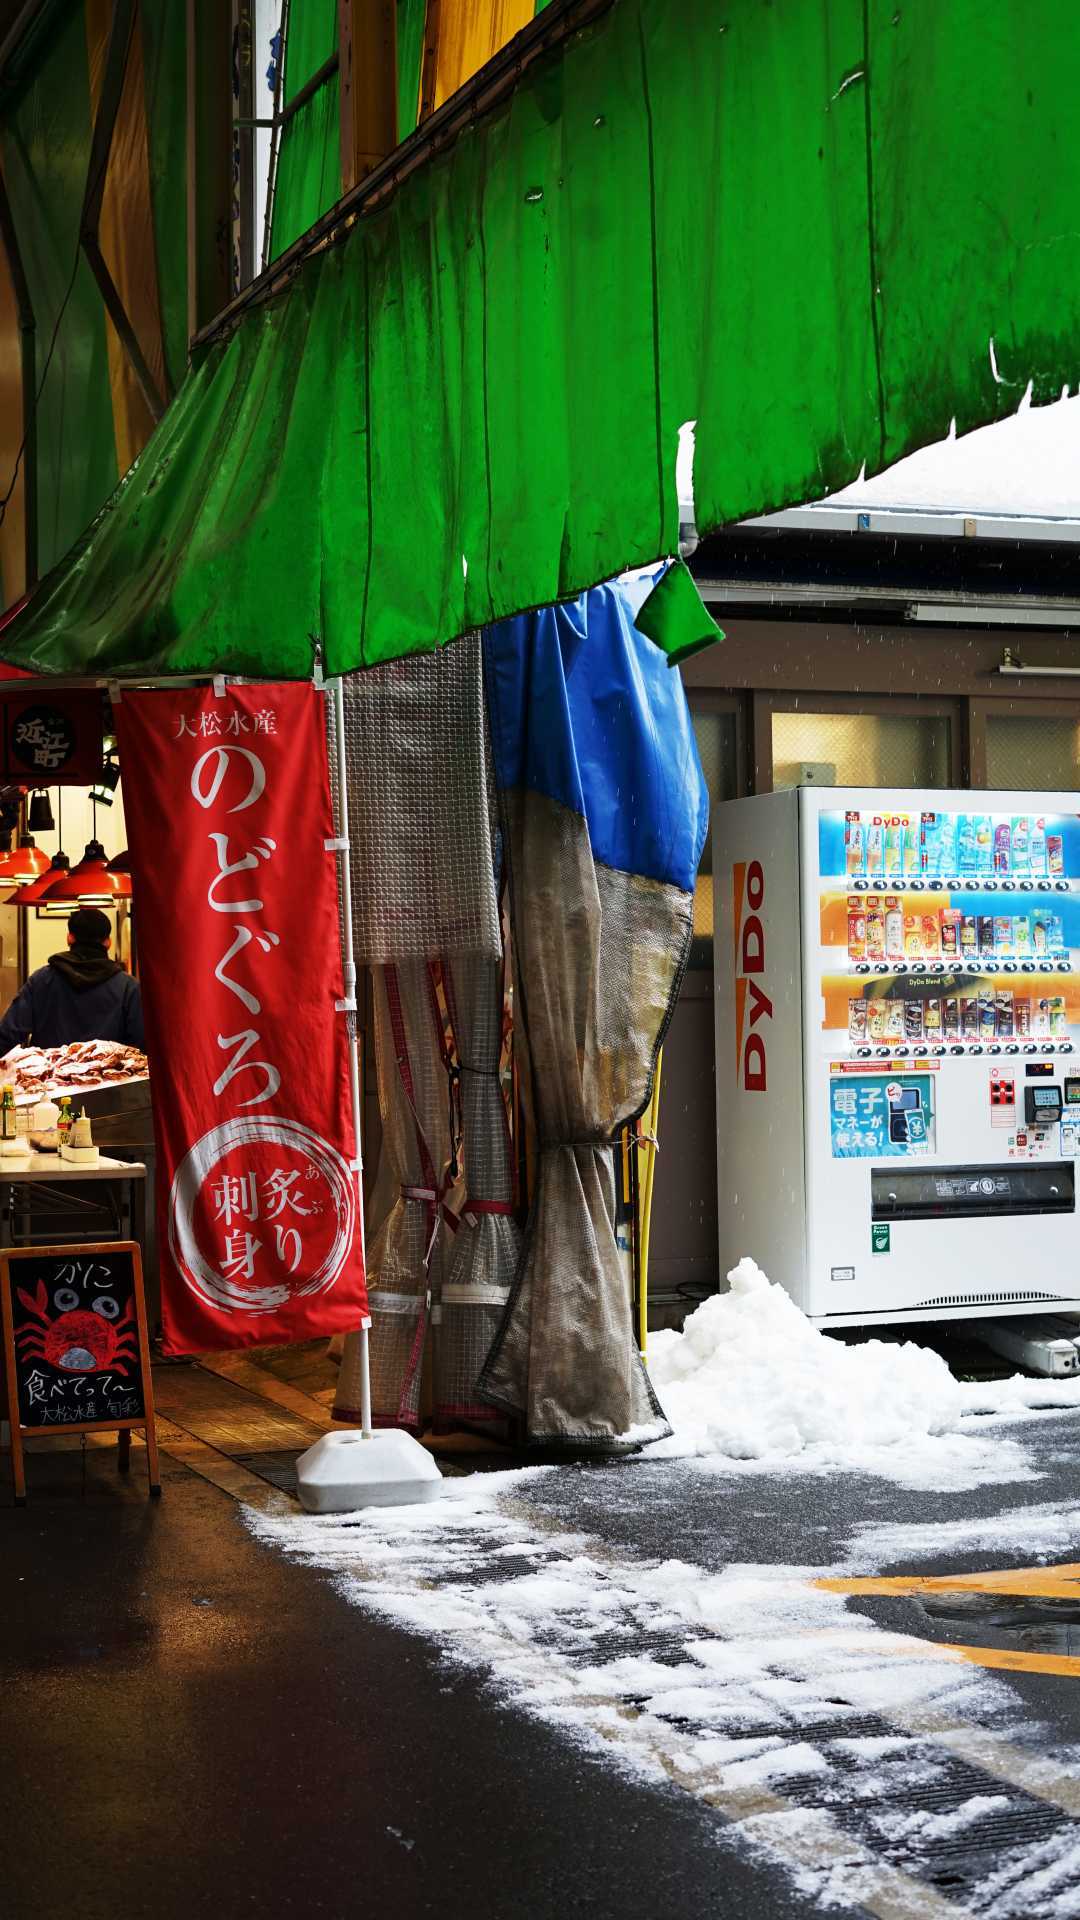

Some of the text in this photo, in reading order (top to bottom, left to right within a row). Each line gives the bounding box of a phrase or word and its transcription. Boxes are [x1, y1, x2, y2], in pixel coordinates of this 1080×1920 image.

[174, 709, 278, 739] 大松水産
[873, 816, 909, 829] DyDo
[190, 744, 282, 1107] のどぐろ
[833, 1087, 884, 1115] 電子
[834, 1115, 883, 1129] マネーが
[210, 1171, 263, 1280] 刺身
[261, 1168, 312, 1274] 炙り
[54, 1262, 113, 1288] かに
